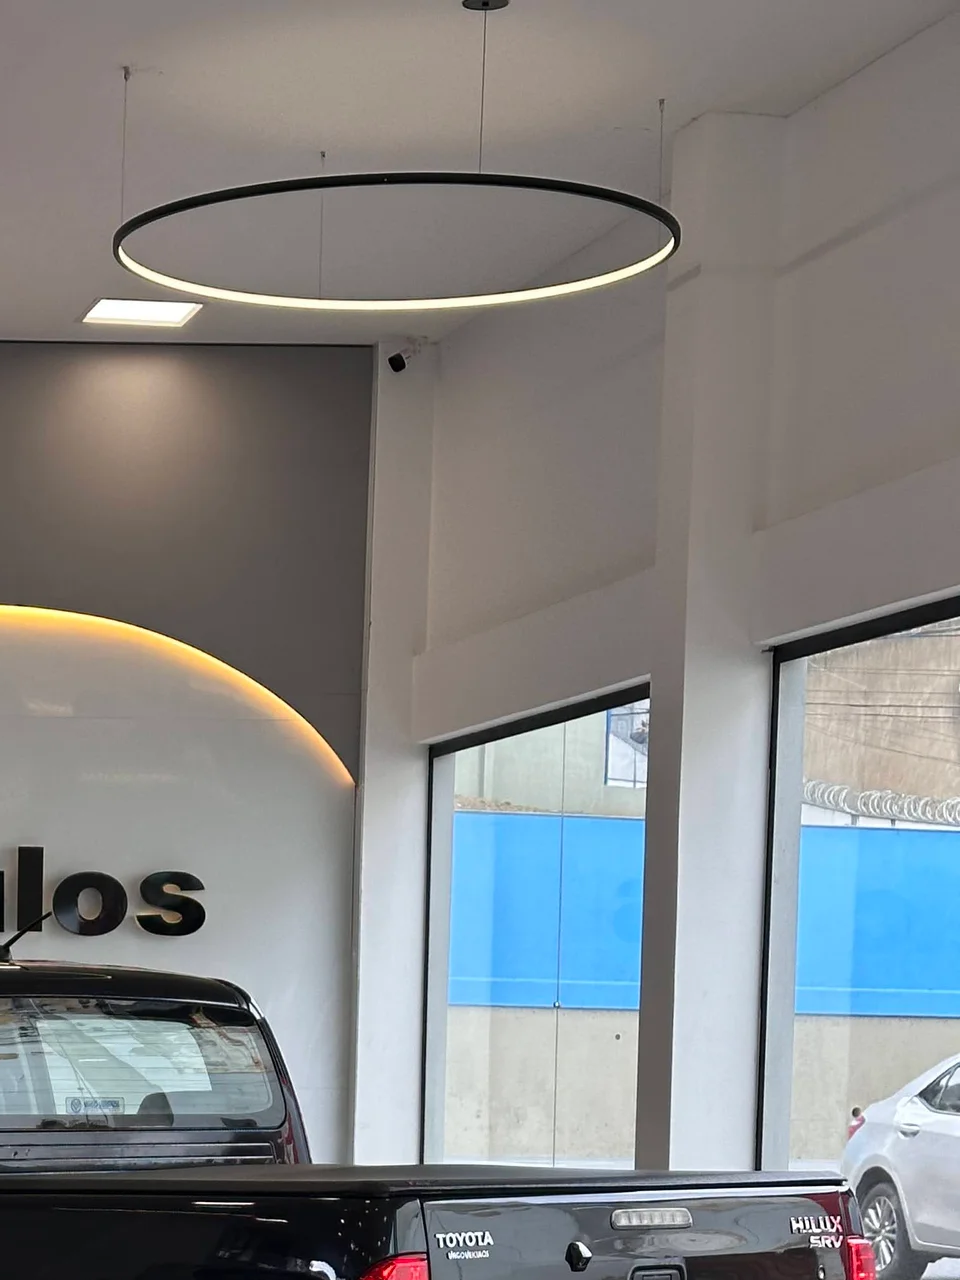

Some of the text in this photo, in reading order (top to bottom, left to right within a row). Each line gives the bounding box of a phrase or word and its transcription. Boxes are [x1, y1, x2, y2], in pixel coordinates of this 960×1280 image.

[791, 1216, 843, 1234] HILUX
[434, 1231, 494, 1248] TOYOTA
[810, 1235, 843, 1248] SRV
